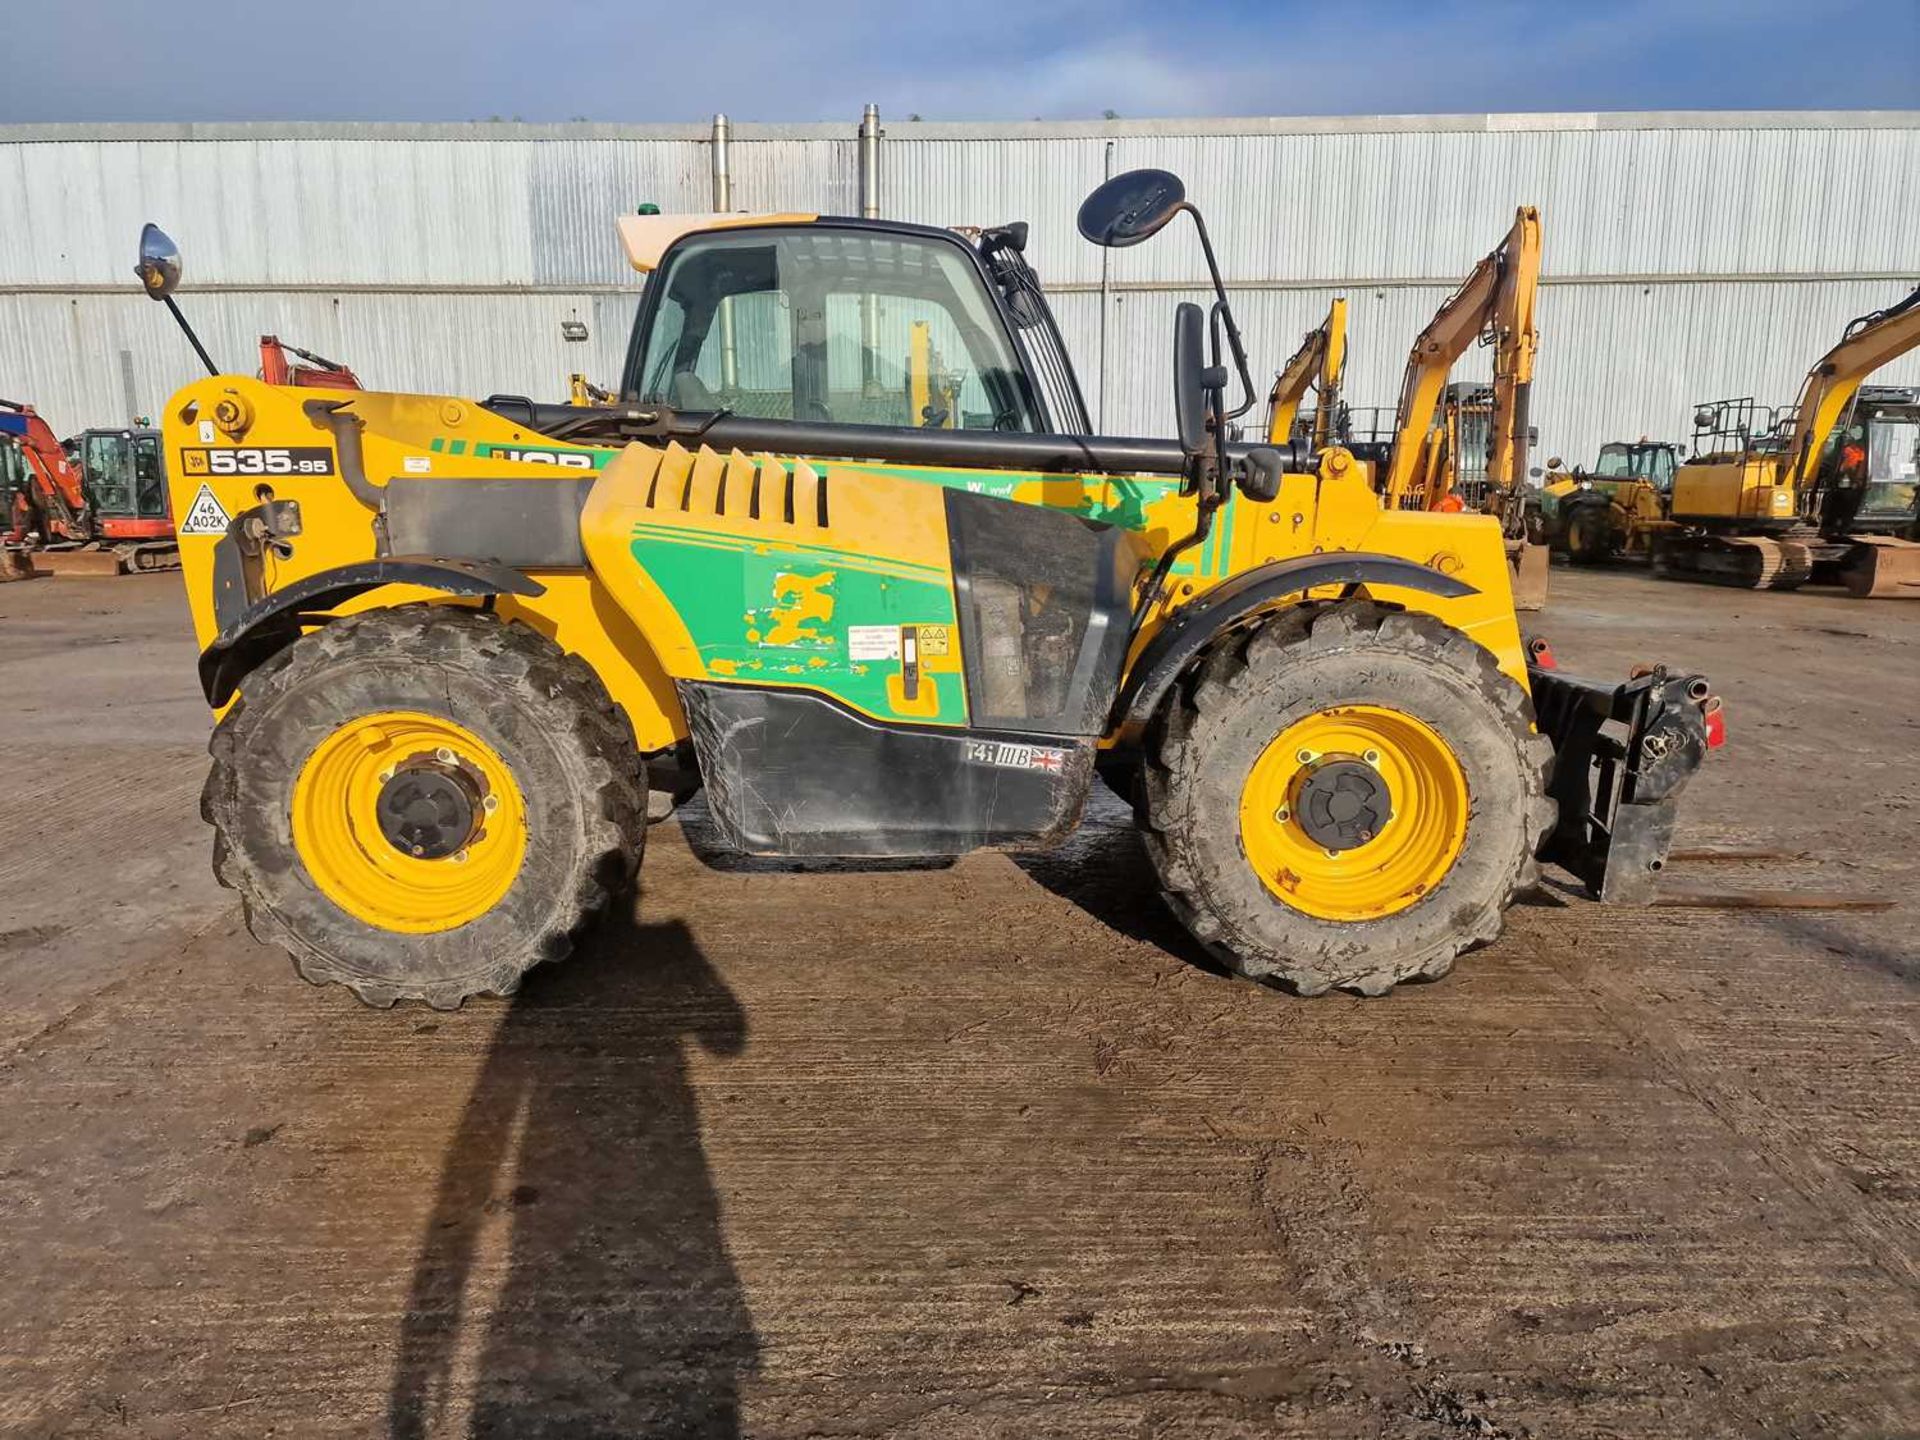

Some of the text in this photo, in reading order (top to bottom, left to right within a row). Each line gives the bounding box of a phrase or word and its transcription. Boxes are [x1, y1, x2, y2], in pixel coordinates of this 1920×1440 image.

[209, 449, 328, 474] 535-95
[199, 502, 215, 515] 46
[192, 515, 225, 528] A02K
